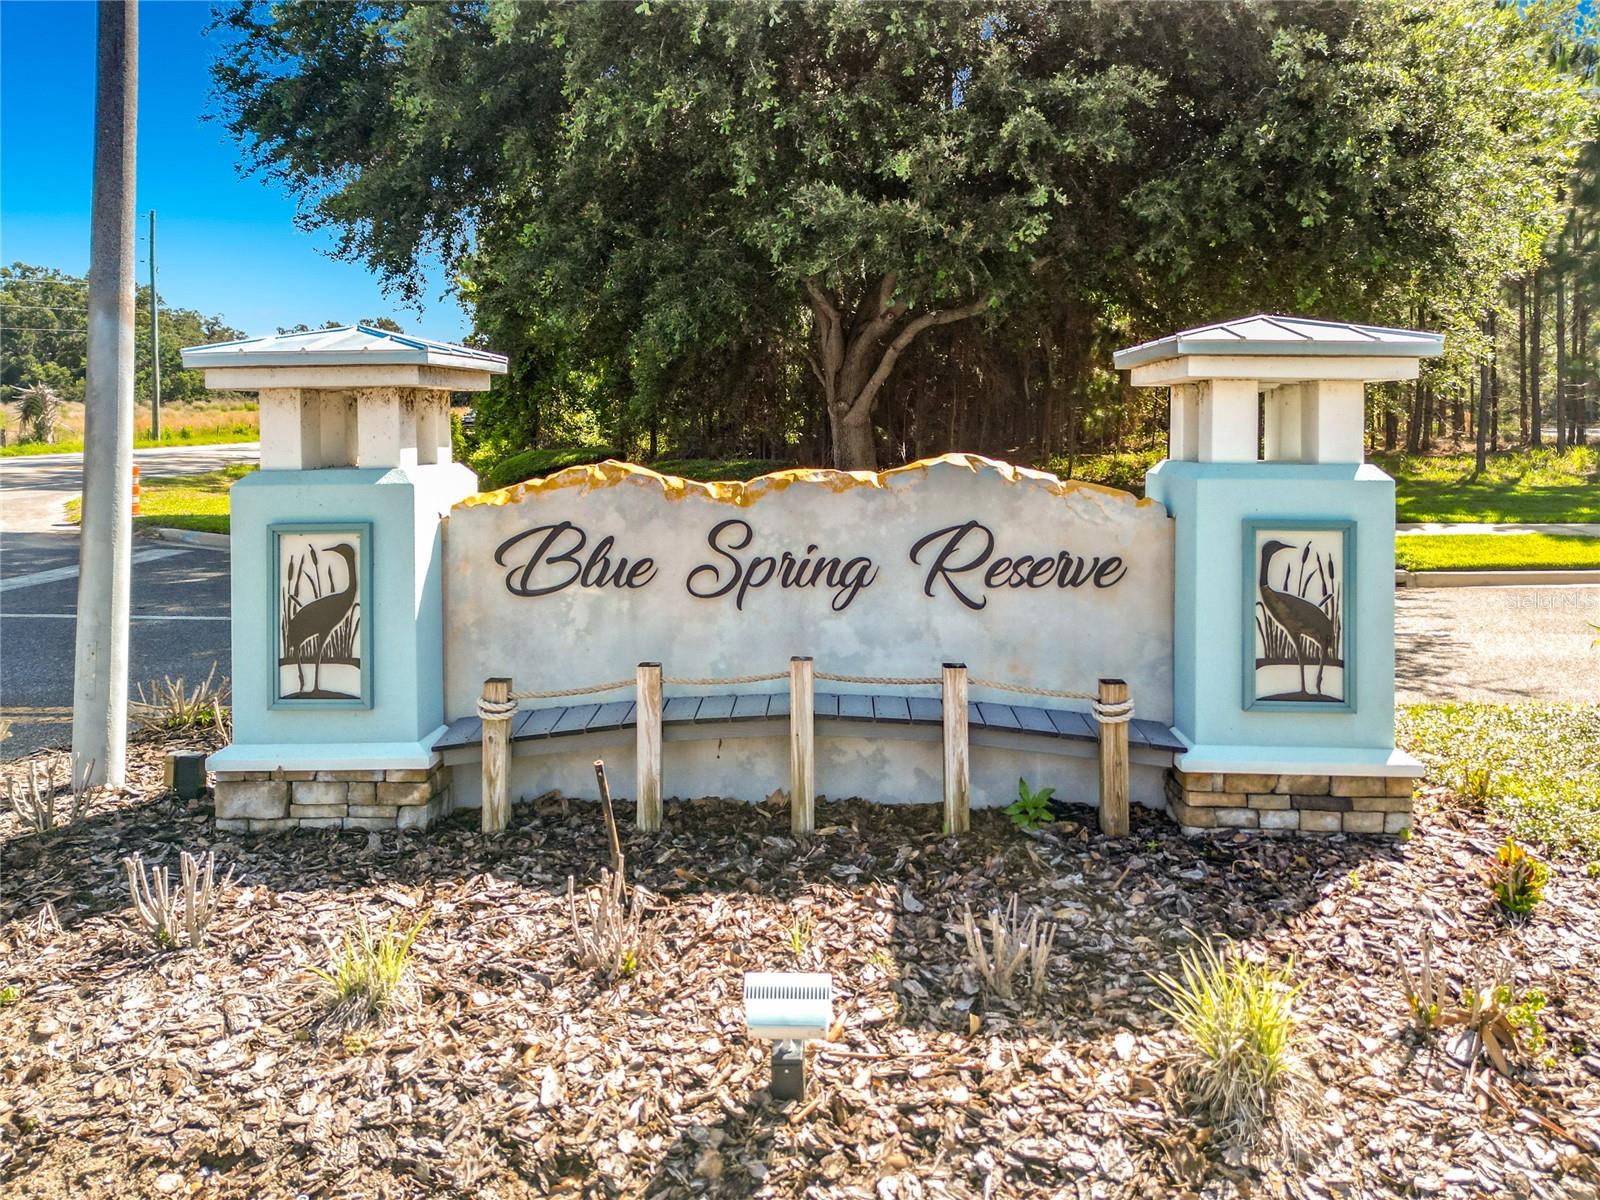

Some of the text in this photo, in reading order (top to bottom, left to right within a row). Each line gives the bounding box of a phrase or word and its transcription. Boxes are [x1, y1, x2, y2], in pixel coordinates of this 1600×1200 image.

[495, 520, 1127, 611] Blue Spring Reserve
